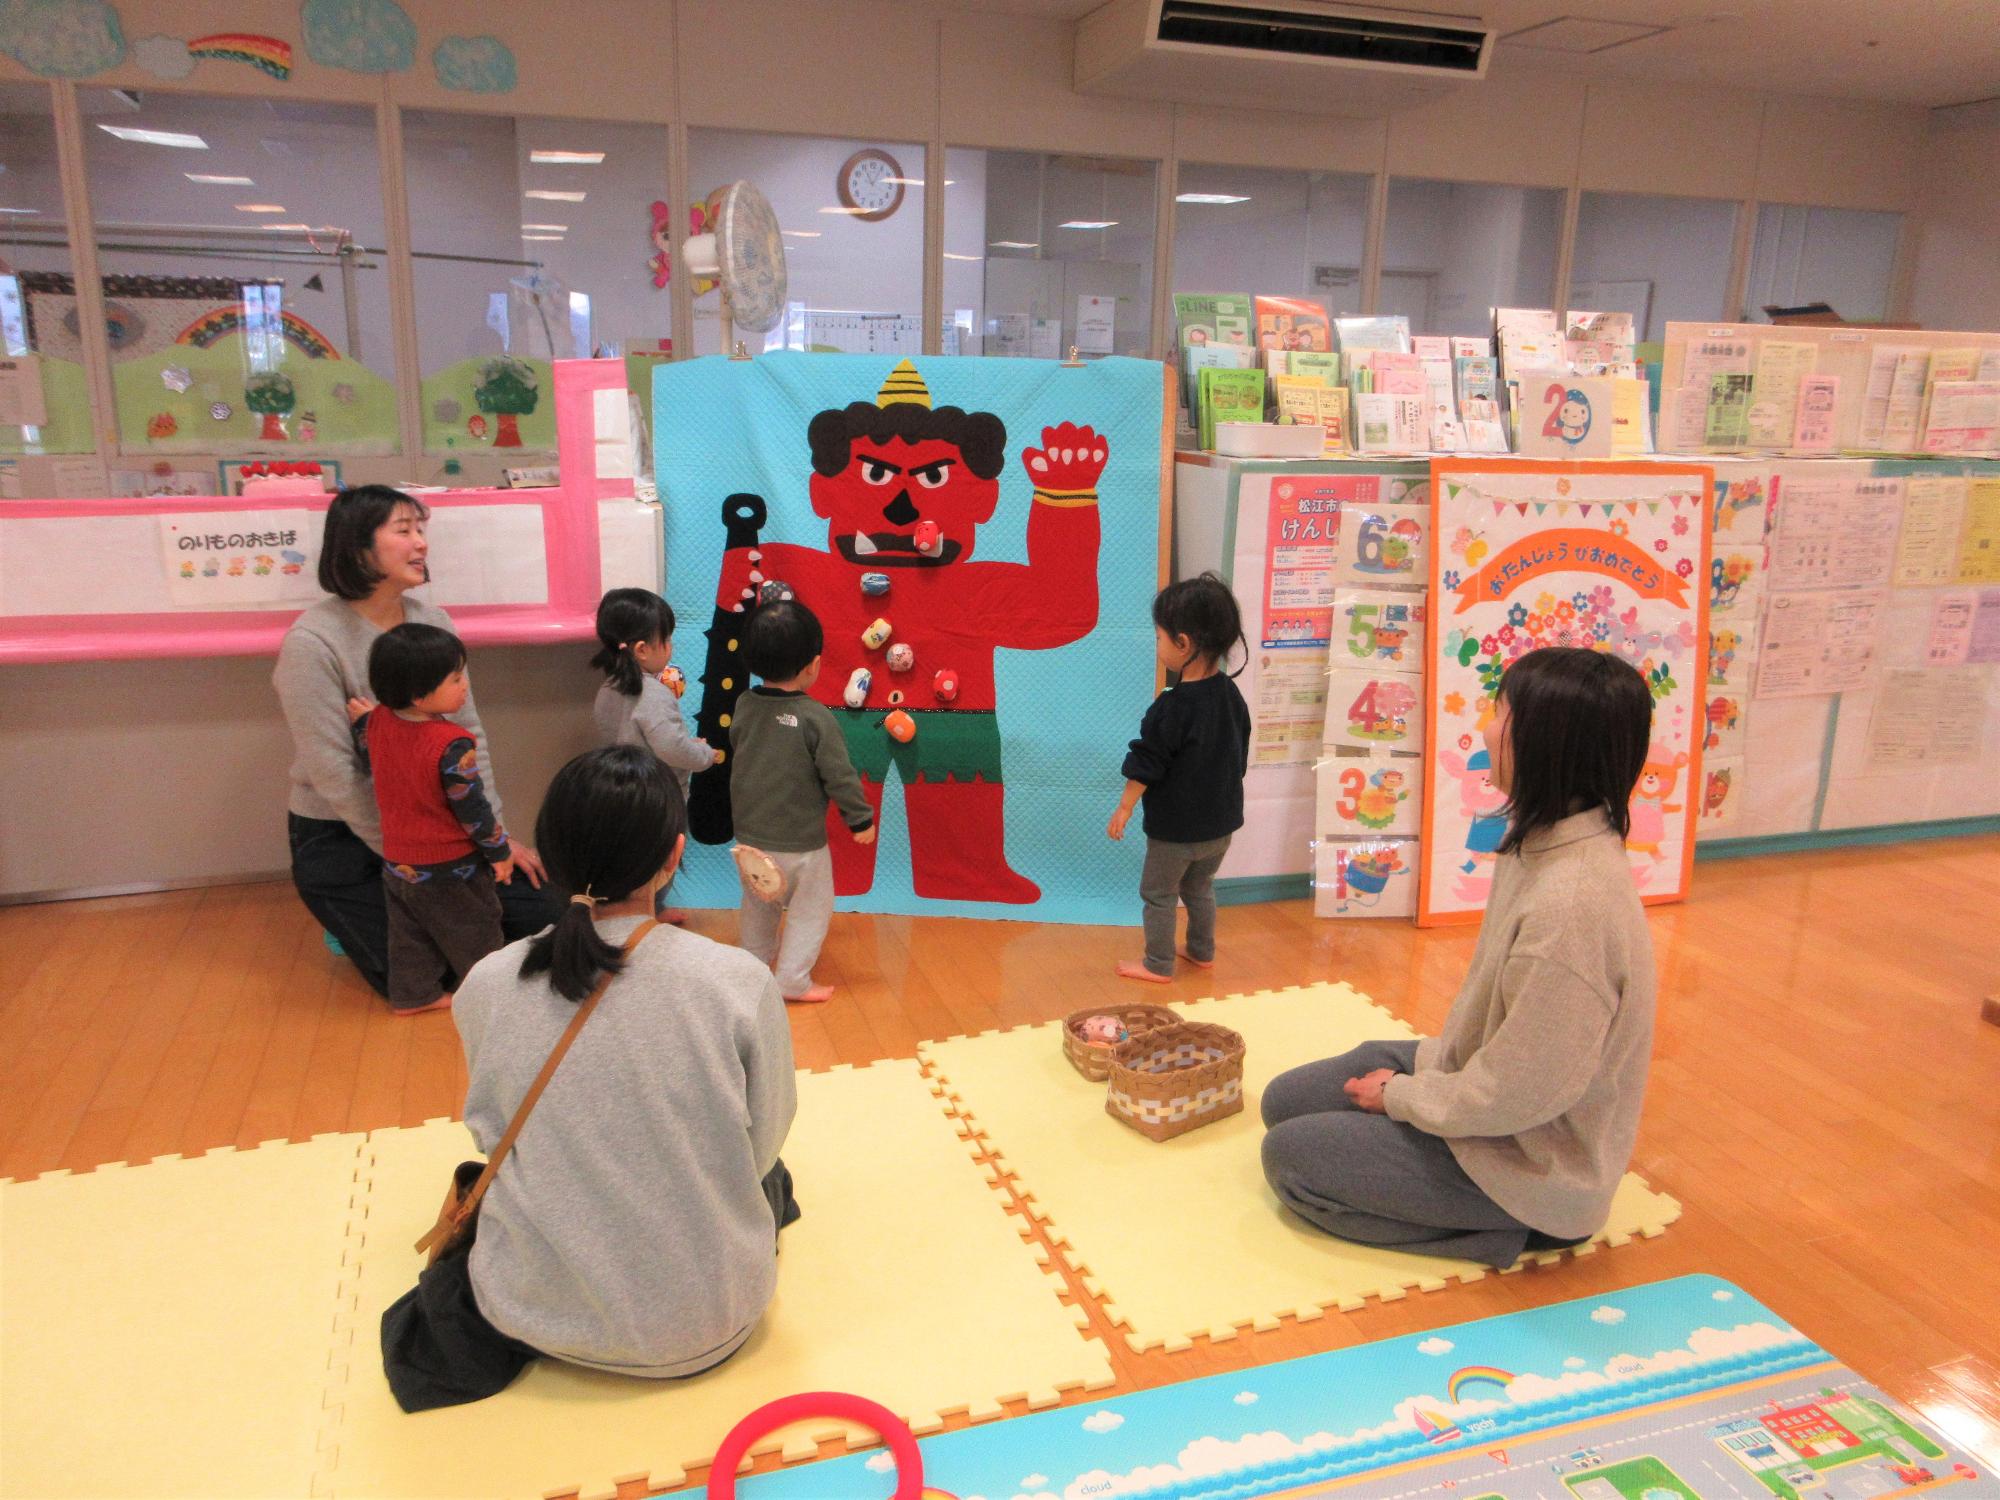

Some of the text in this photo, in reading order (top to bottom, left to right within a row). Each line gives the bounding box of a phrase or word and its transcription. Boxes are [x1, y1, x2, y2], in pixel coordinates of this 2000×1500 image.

[1298, 498, 1338, 514] 松江市
[178, 530, 298, 551] のりものおきば
[1357, 514, 1388, 567] 6
[1347, 604, 1379, 658] 5
[1347, 679, 1380, 733] 4
[1335, 767, 1367, 821] 3
[1336, 849, 1347, 900] 1
[1080, 1480, 1112, 1495] cloud
